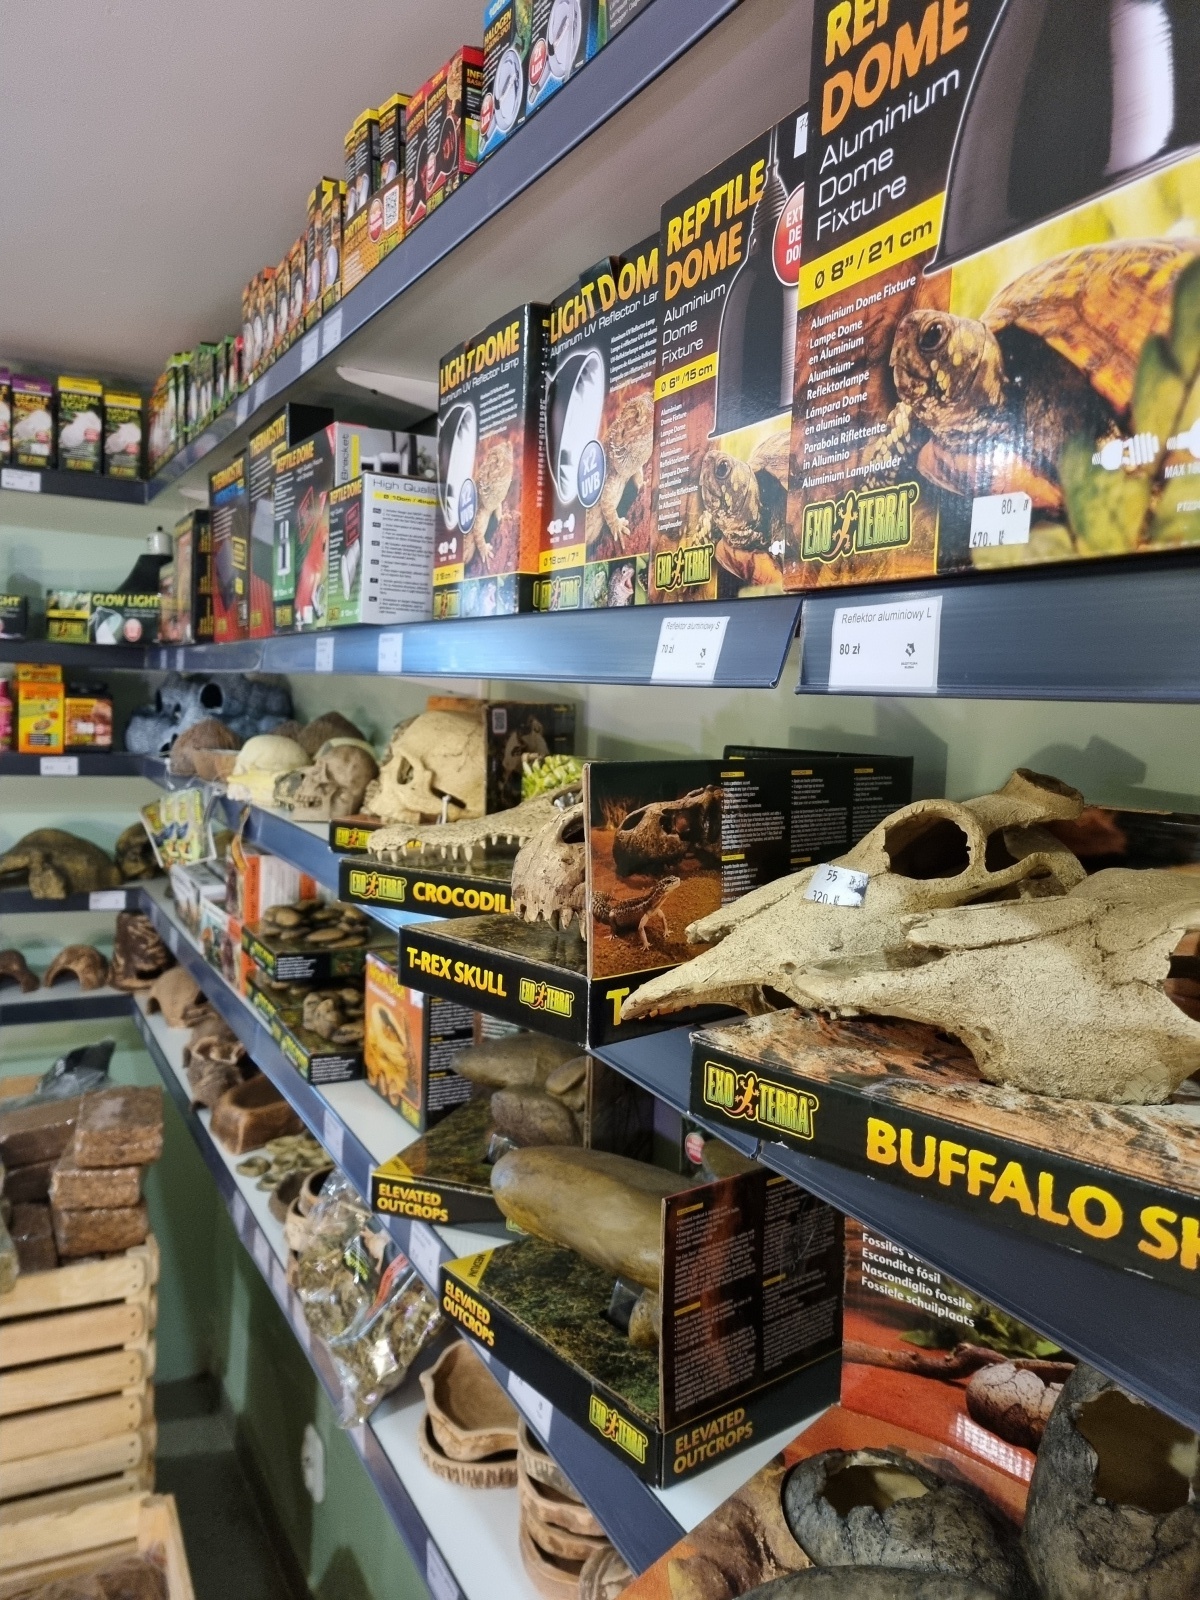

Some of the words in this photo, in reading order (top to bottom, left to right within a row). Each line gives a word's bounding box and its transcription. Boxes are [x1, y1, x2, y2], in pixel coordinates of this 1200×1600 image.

[485, 8, 512, 42] HALOGEN
[822, 0, 970, 136] DOME
[819, 68, 960, 175] Aluminium
[818, 147, 894, 208] Dome
[667, 158, 765, 257] REPTILE
[816, 175, 907, 241] Fixture
[900, 219, 933, 248] cm
[664, 221, 743, 301] DOME
[785, 246, 801, 266] DO
[550, 282, 596, 345] LIGHT
[663, 283, 726, 326] Aluminium
[810, 305, 854, 331] Aluminium
[856, 292, 882, 311] Dome
[883, 275, 917, 299] Fixture
[550, 331, 583, 359] Aluminum
[584, 321, 597, 338] UV
[599, 300, 640, 329] Reflector
[662, 319, 699, 346] Dome
[809, 331, 836, 350] Lampe
[838, 320, 863, 338] Dome
[440, 349, 475, 395] LIGHT
[475, 321, 520, 374] DOME
[661, 338, 704, 367] Fixture
[808, 355, 819, 366] en
[820, 336, 864, 362] Aluminium
[462, 381, 472, 394] UV
[472, 367, 500, 388] Reflector
[500, 357, 520, 373] Lamp
[698, 363, 713, 377] cm
[807, 371, 870, 401] Reflektorlampe
[808, 360, 855, 385] Aluminium-
[805, 402, 840, 420] Lámpara
[842, 391, 868, 408] Dome
[804, 434, 839, 454] Parabola
[840, 422, 887, 444] Riflettente
[805, 425, 815, 436] en
[816, 413, 851, 432] aluminio
[583, 450, 598, 476] X2
[801, 472, 845, 489] Aluminium
[846, 455, 901, 479] Lamphouder
[803, 460, 811, 470] in
[812, 449, 850, 467] Alluminio
[373, 479, 400, 491] High
[582, 477, 600, 499] UVB
[805, 503, 833, 555] EXO
[857, 489, 908, 548] TERRA
[657, 554, 672, 588] EXO
[684, 545, 710, 585] TERRA
[93, 593, 126, 607] GLOW
[128, 594, 160, 608] LIGHT
[841, 612, 877, 624] Reflektor
[877, 608, 925, 621] aluminiowy
[926, 607, 932, 618] L
[715, 621, 721, 630] S
[839, 643, 850, 655] 80
[852, 642, 861, 655] zł
[351, 872, 367, 893] EXO
[378, 876, 405, 900] TERRA
[826, 869, 838, 882] 55
[412, 881, 515, 914] CROCODIL
[406, 946, 454, 980] T-REX
[454, 961, 507, 998] SKULL
[521, 979, 536, 1001] EXO
[547, 985, 571, 1015] TERRA
[707, 1066, 735, 1107] EXO
[759, 1083, 810, 1135] TERRA
[378, 1183, 442, 1207] ELEVATED
[866, 1117, 1124, 1240] BUFFALO
[377, 1198, 449, 1223] OUTCROPS
[862, 1232, 904, 1257] Fossiles
[467, 1253, 487, 1278] MEDIUM
[862, 1247, 915, 1275] Escondite
[917, 1266, 941, 1284] fósil
[445, 1279, 491, 1325] ELEVATED
[861, 1261, 933, 1297] Nascondiglio
[935, 1288, 973, 1311] fossile
[861, 1276, 904, 1301] Fossiele
[906, 1295, 975, 1328] schuilplaats
[443, 1296, 495, 1347] OUTCROPS
[592, 1397, 607, 1430] EXO
[618, 1419, 643, 1459] TERRA
[675, 1408, 745, 1455] ELEVATED
[673, 1421, 753, 1475] OUTCROPS
